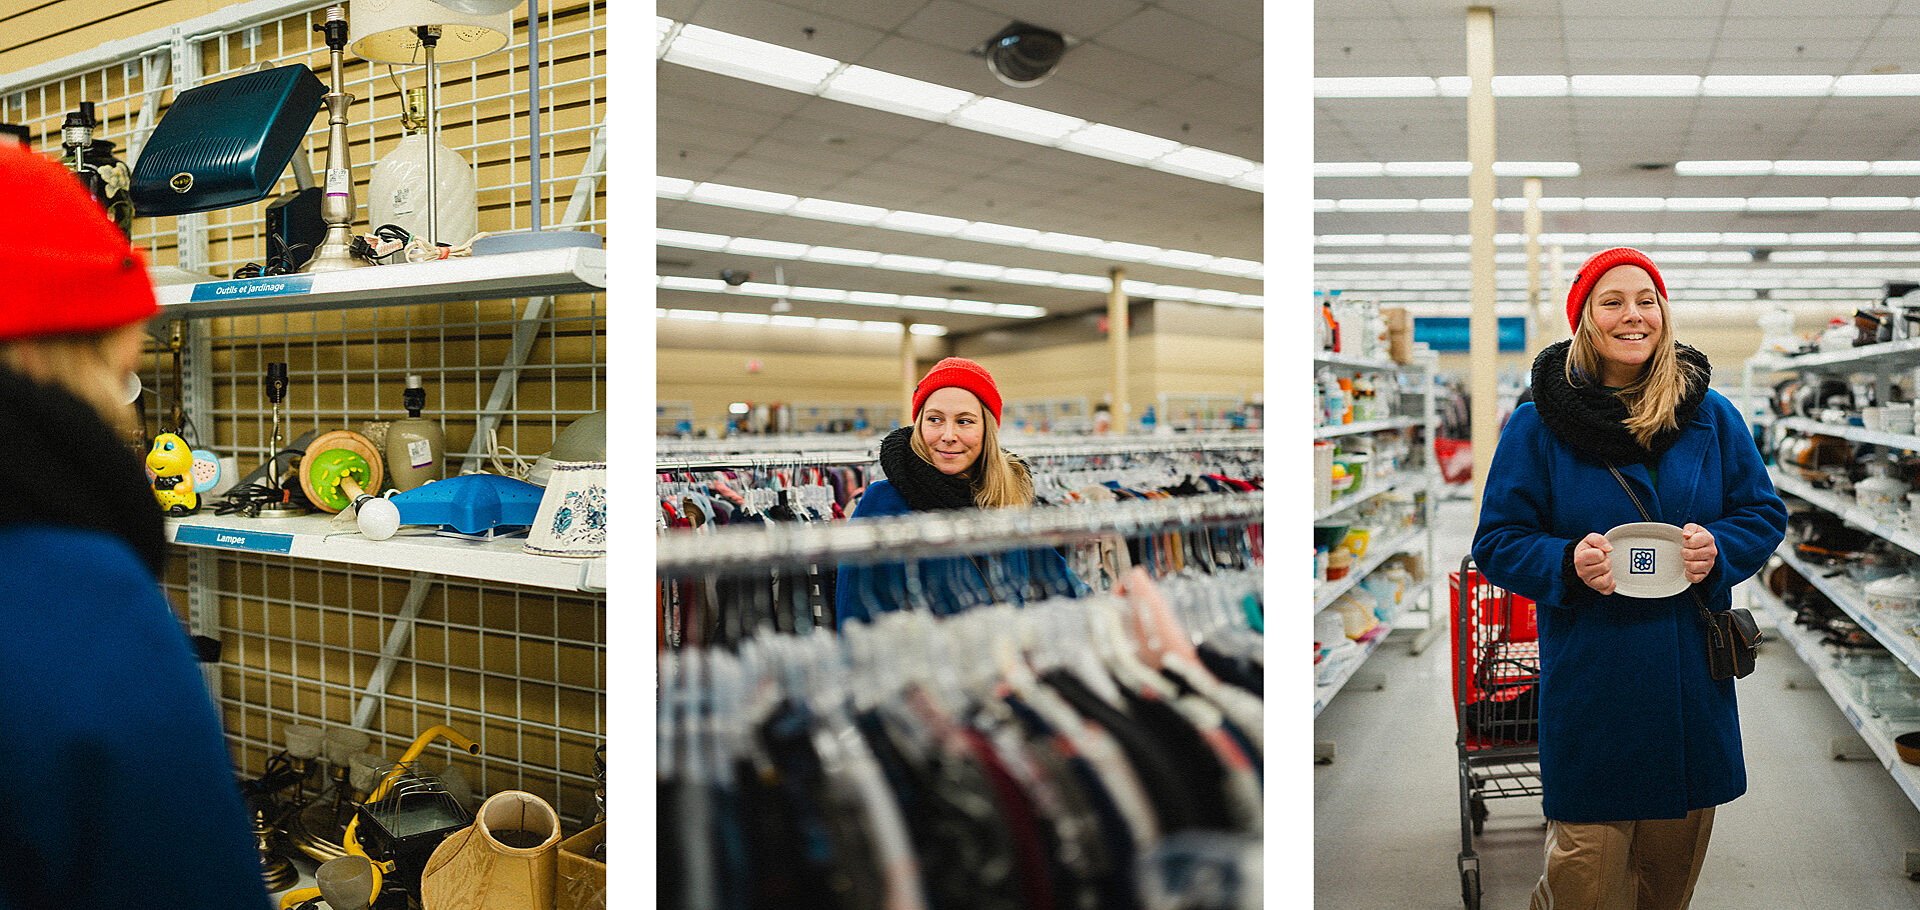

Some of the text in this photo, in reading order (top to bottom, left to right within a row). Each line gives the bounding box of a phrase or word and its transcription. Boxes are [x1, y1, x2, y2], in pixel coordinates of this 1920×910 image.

[216, 285, 238, 295] Outils
[247, 283, 285, 294] jardinage
[216, 533, 246, 545] Lampes
